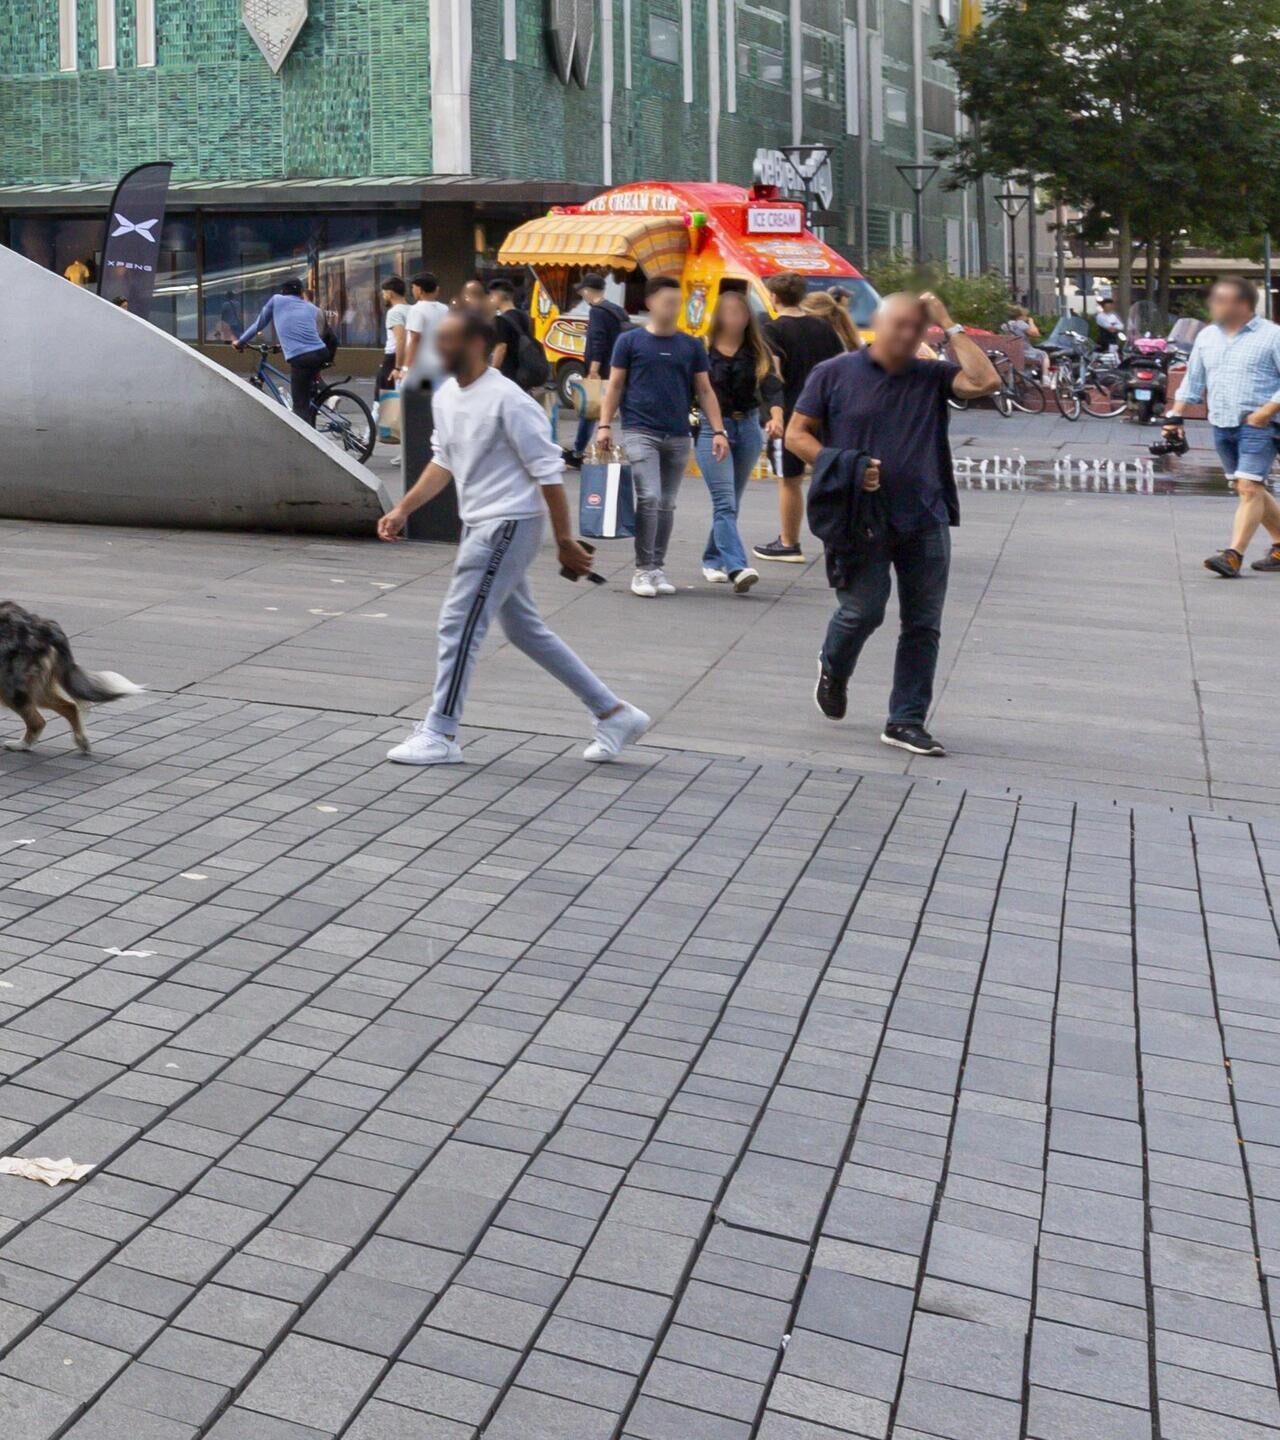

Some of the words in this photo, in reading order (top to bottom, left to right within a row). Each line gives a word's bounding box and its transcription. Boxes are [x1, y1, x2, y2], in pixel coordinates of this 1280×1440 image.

[608, 191, 649, 211] CREAM
[652, 192, 678, 211] CAR
[753, 211, 766, 227] ICE
[768, 211, 796, 227] CREAM
[107, 260, 153, 272] XPENG
